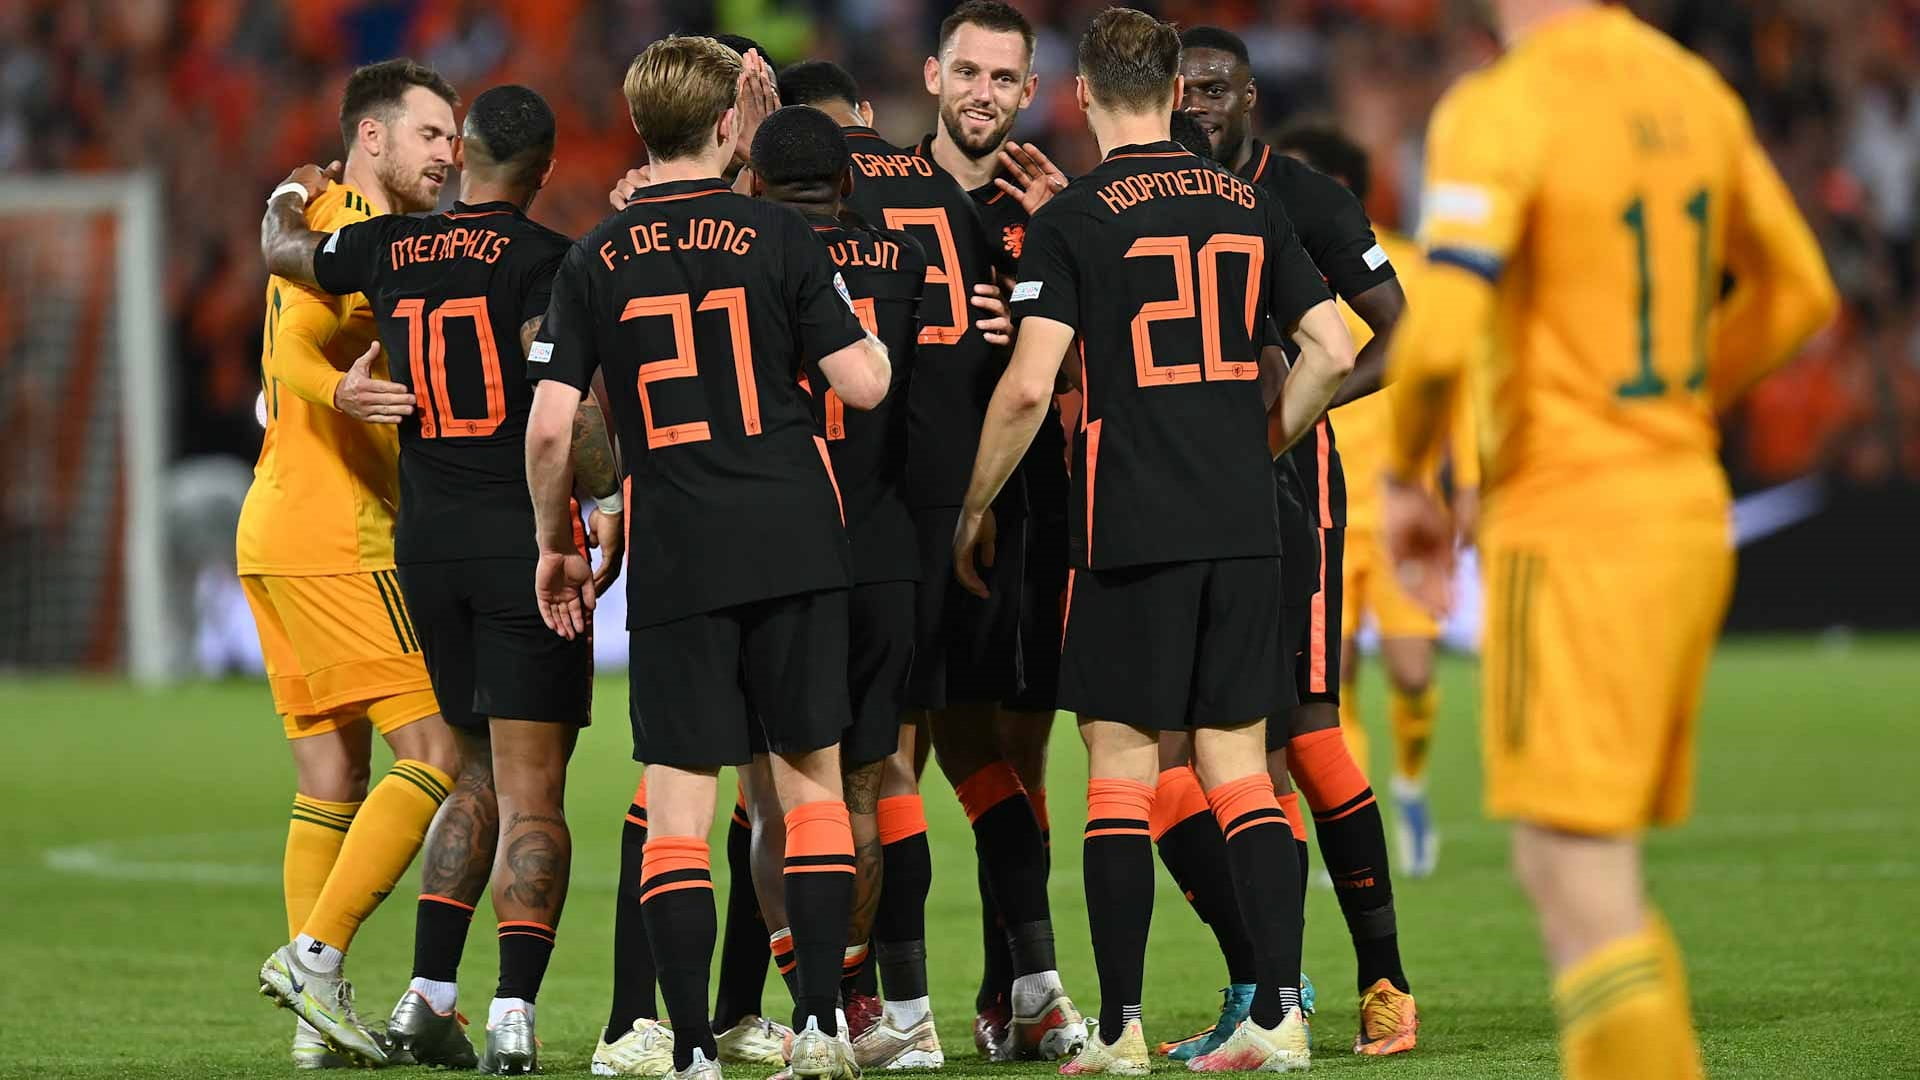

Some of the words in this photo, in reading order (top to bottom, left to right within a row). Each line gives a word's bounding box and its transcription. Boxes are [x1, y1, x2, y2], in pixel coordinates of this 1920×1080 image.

[850, 152, 934, 178] GAKPO
[1096, 168, 1257, 215] KOOPMEINERS
[390, 227, 511, 272] MEMPHIS
[599, 239, 630, 272] F.
[628, 222, 672, 255] DE
[677, 218, 757, 256] JONG
[1616, 185, 1711, 398] 11
[1122, 233, 1265, 388] 20
[391, 296, 507, 439] 10
[618, 286, 762, 450] 21
